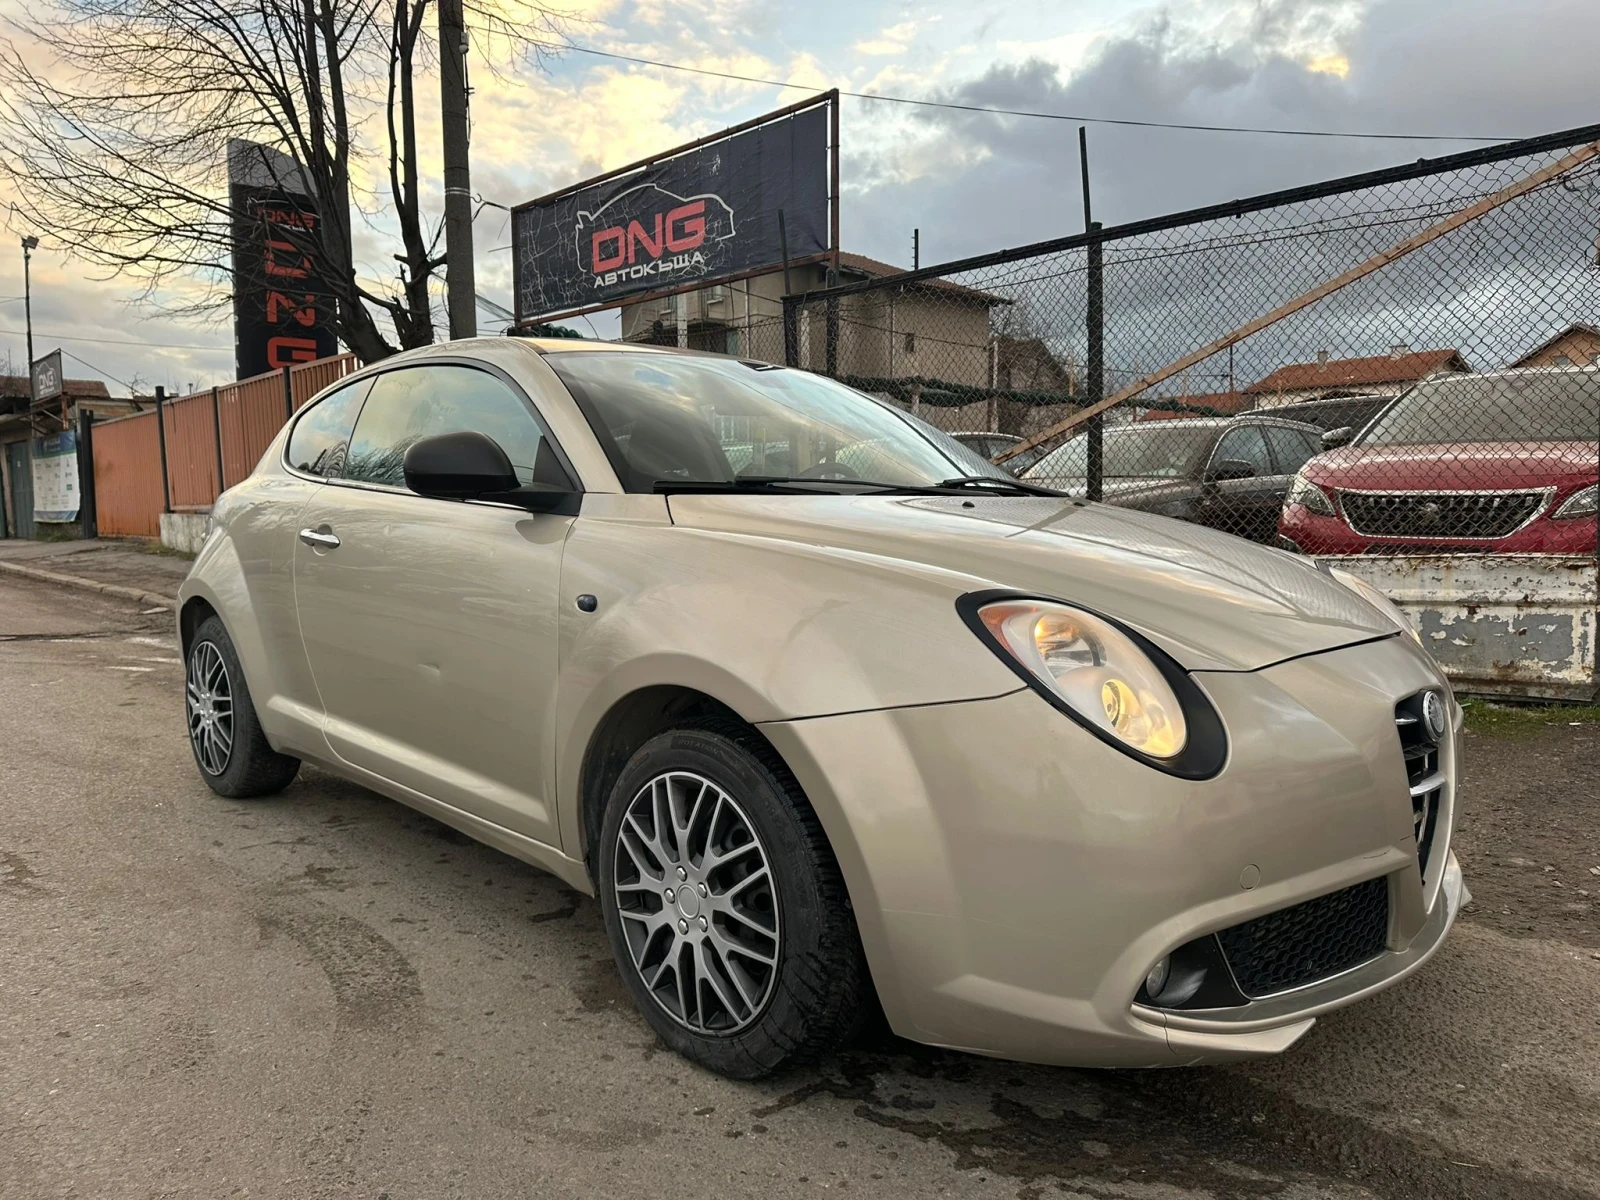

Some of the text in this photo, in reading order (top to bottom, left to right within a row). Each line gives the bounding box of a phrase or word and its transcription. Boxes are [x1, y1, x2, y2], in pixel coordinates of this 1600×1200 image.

[592, 200, 706, 274] DNG
[593, 251, 705, 289] АВТОКЪЩА
[677, 739, 721, 755] ROTATION
